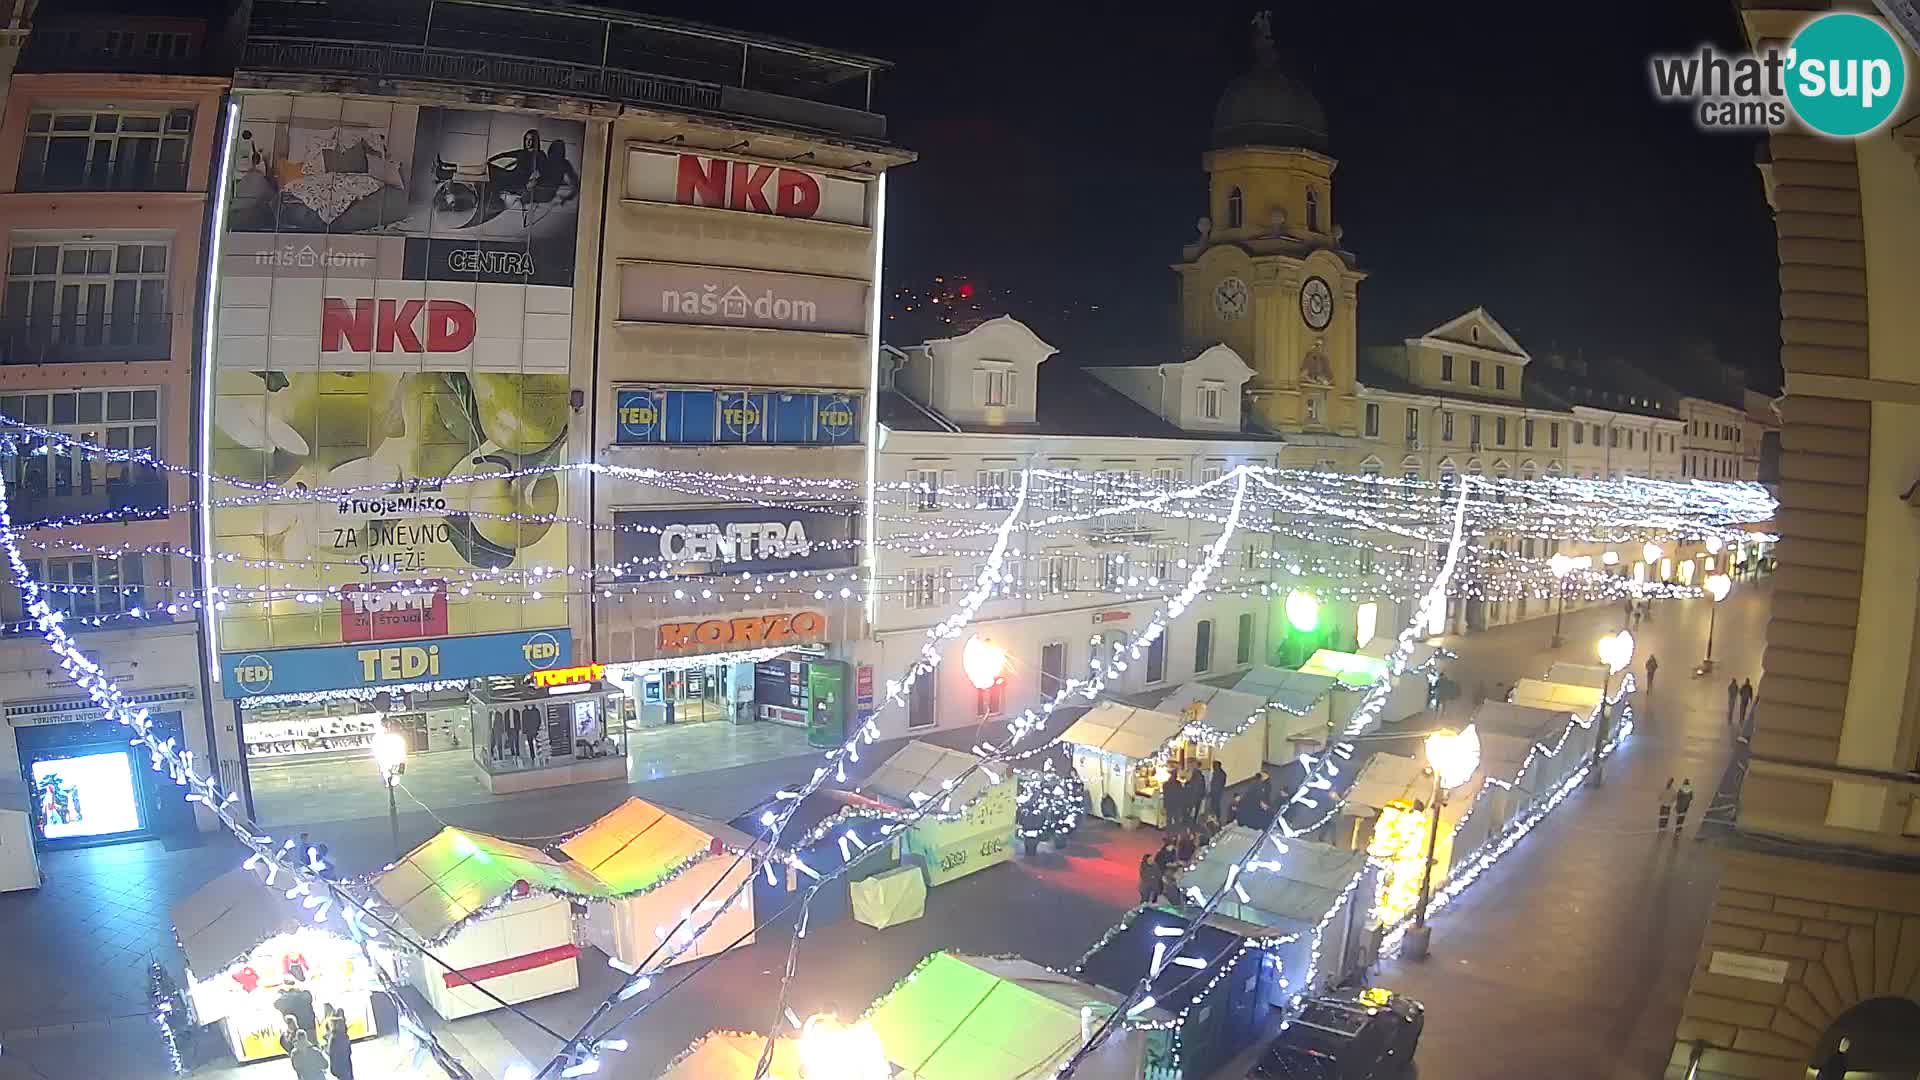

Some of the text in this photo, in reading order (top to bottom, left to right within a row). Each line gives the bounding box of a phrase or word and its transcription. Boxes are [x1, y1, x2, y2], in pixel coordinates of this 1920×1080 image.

[676, 154, 821, 219] NKD
[255, 246, 367, 269] naš dom
[449, 250, 535, 275] CENTRA
[662, 284, 817, 323] naš dom
[321, 297, 477, 353] NKD
[333, 523, 450, 548] ZA DNEVNO
[660, 520, 810, 563] CENTRA
[658, 611, 826, 650] KORZO
[358, 644, 439, 681] TEDi
[522, 642, 560, 659] TEDi
[234, 666, 273, 684] TEDi
